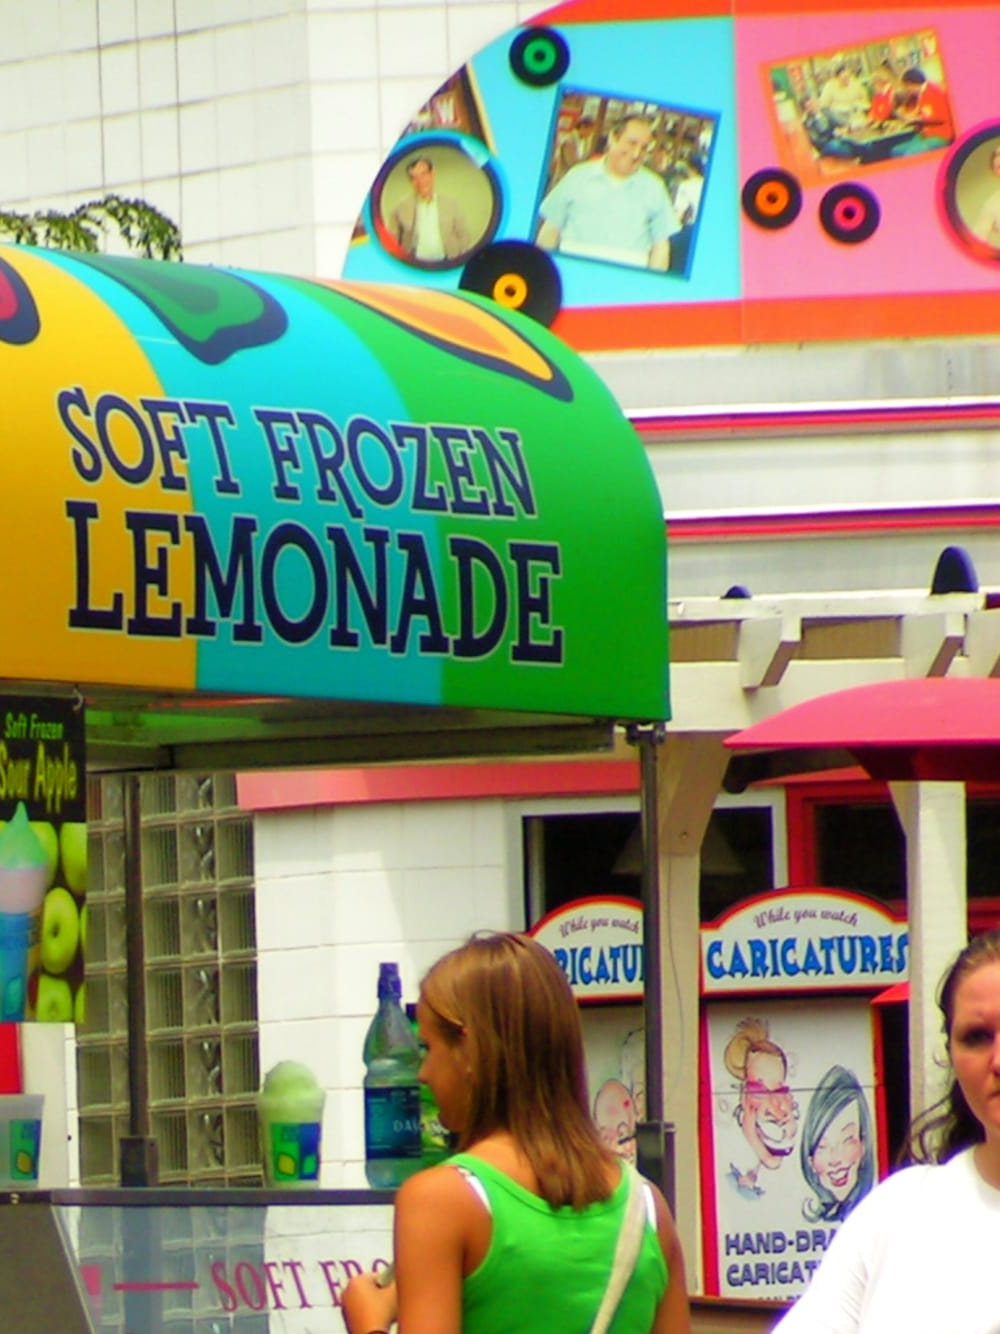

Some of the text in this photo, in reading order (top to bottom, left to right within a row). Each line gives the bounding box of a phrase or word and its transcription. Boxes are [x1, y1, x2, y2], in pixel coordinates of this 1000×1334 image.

[57, 386, 537, 519] SOFT FROZEN
[65, 500, 563, 665] LEMONADE
[34, 740, 78, 814] Apple
[754, 906, 859, 928] While you watch
[706, 933, 909, 979] CARICATURES
[210, 1259, 313, 1312] SOFT
[726, 1259, 821, 1287] CARICAT
